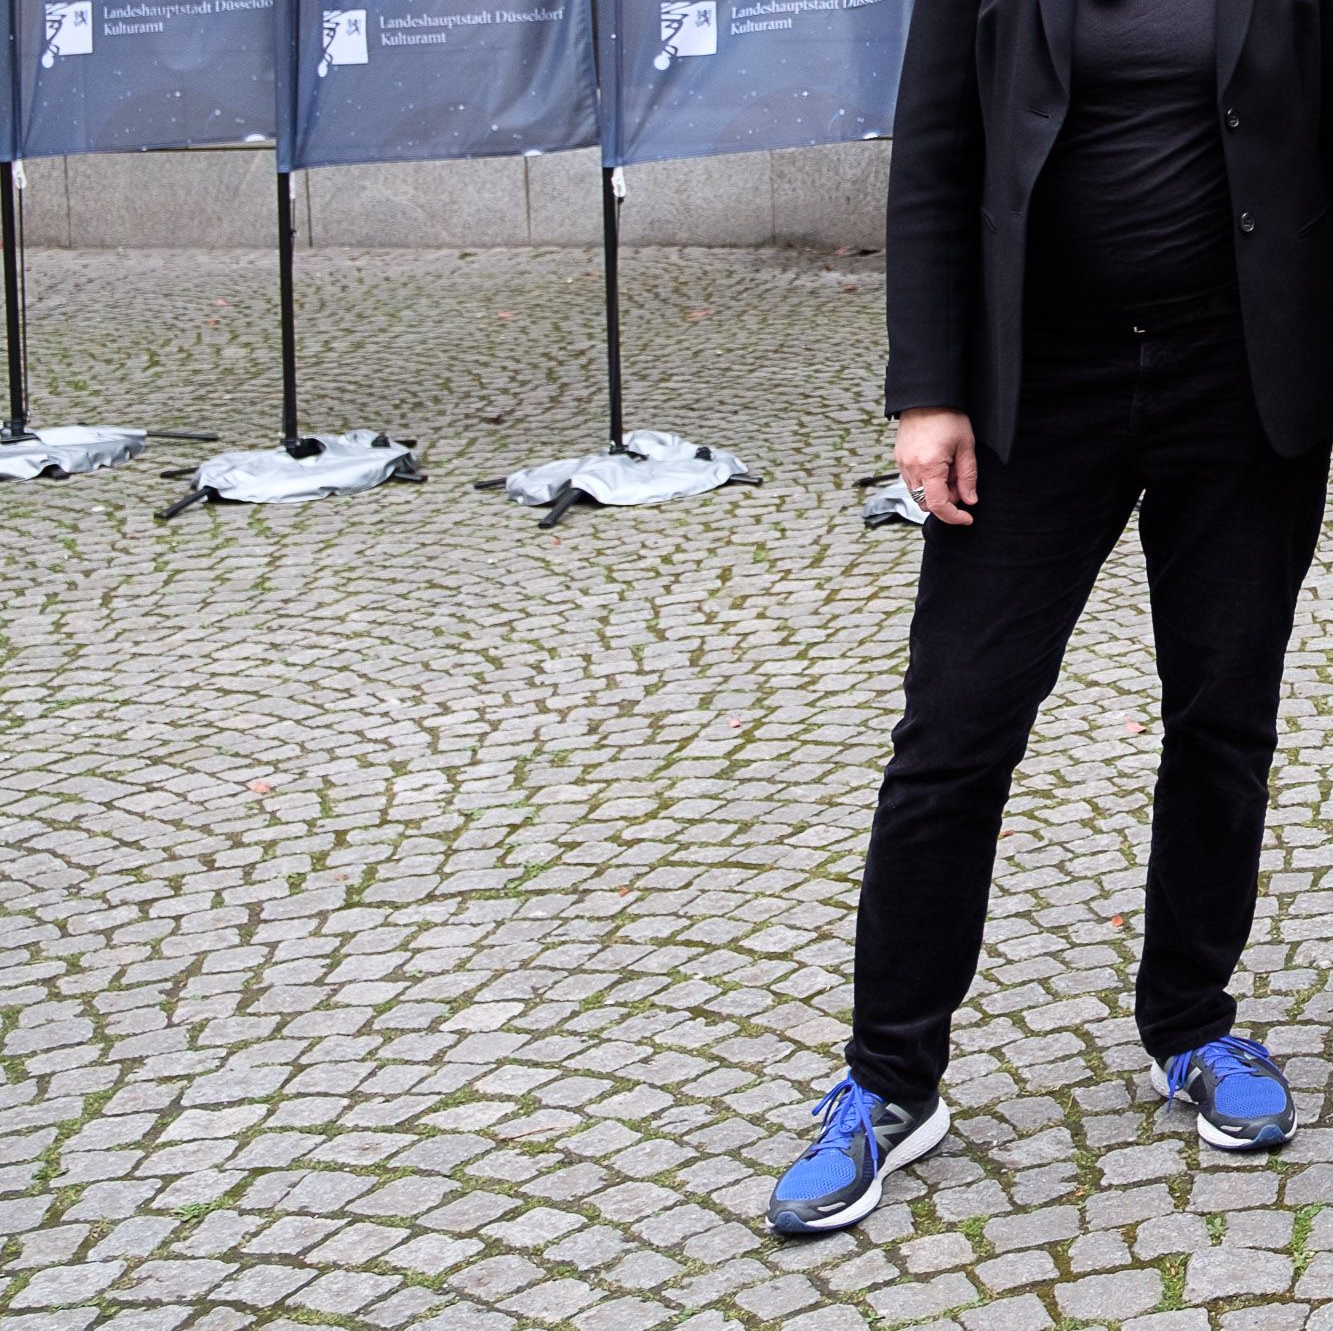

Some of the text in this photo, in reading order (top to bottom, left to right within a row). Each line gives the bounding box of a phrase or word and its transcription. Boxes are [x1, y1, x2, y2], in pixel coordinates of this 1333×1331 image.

[103, 0, 212, 19] Landeshauptstadt
[379, 6, 565, 29] Landeshauptstadt Düsseldorf
[104, 21, 164, 36] Kulturamt
[730, 18, 793, 35] Kulturamt
[381, 32, 447, 46] Kulturamt
